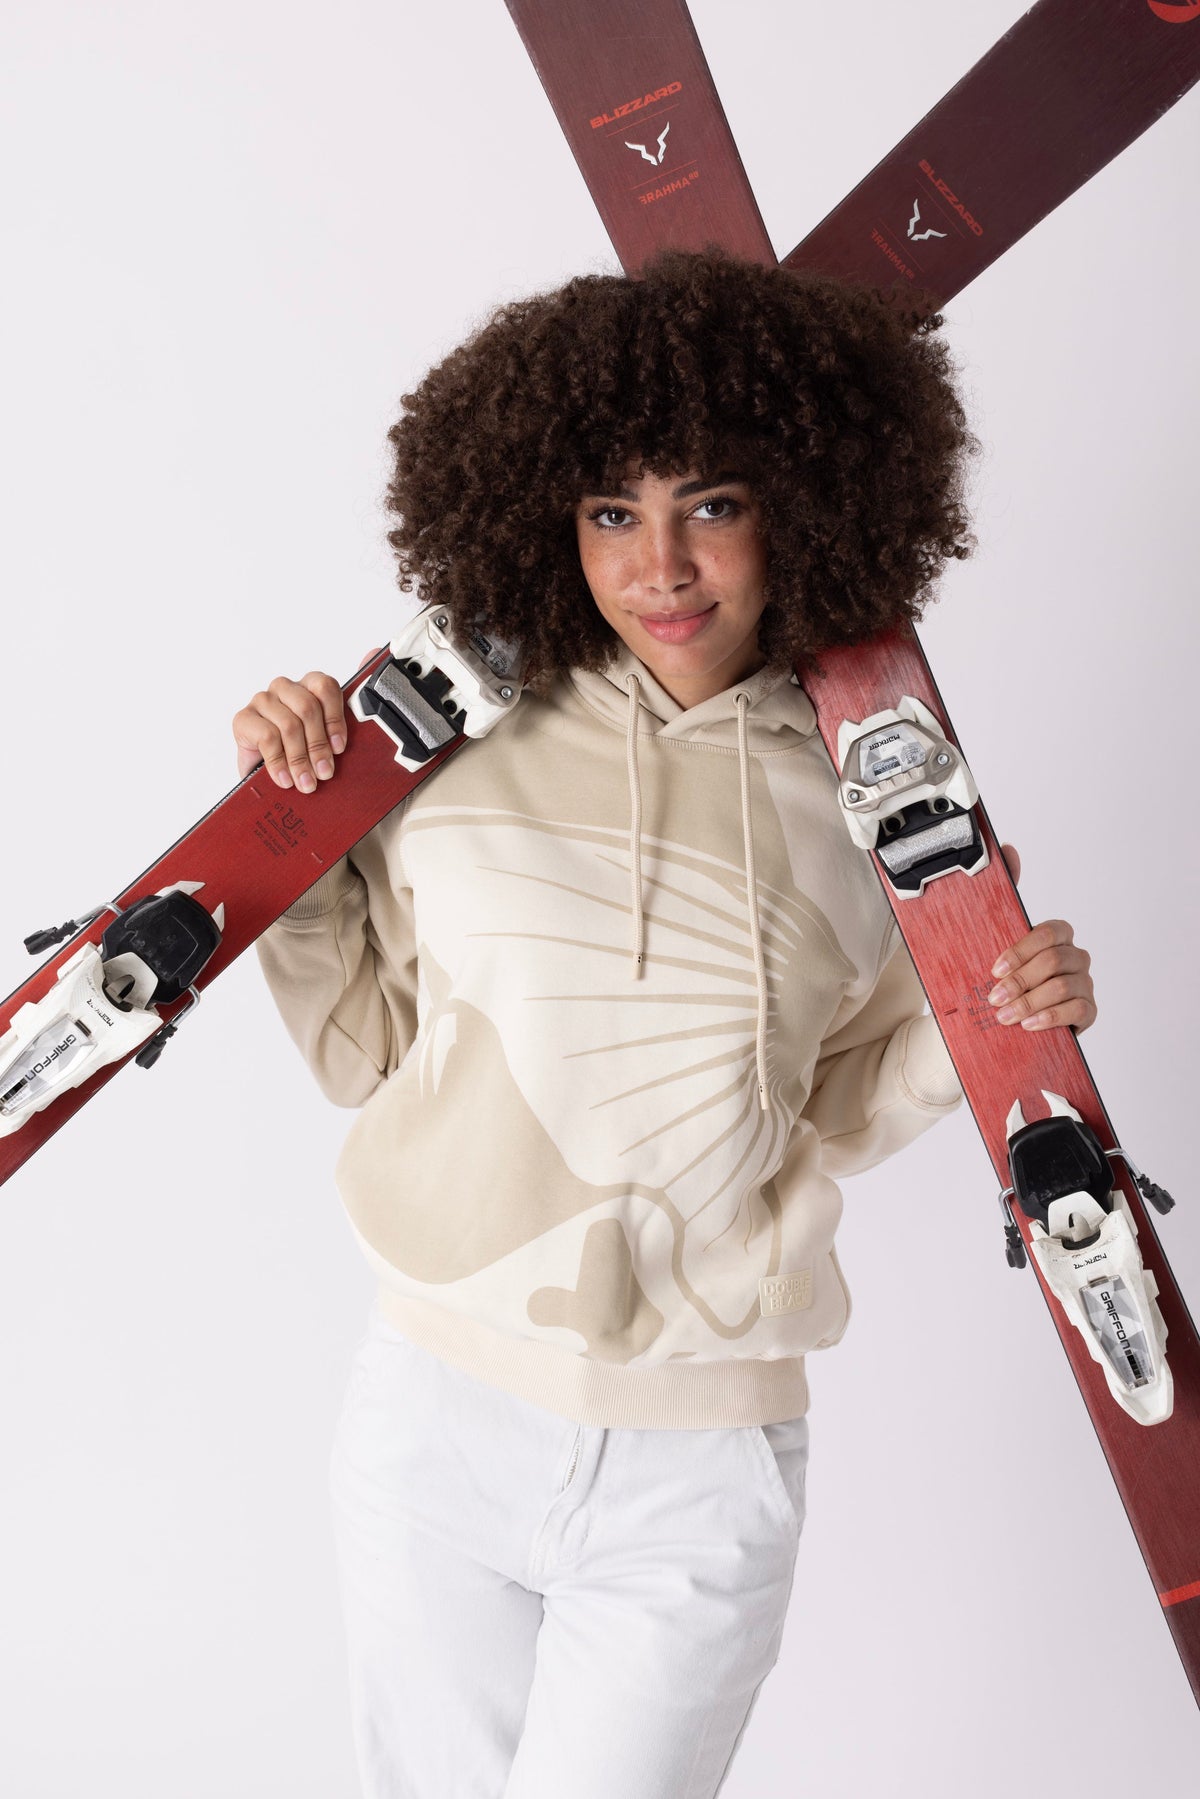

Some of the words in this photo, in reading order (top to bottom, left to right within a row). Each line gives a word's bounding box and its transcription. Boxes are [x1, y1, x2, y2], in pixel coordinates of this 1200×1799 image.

[590, 81, 682, 129] BLIZZARD
[918, 159, 984, 236] BLIZZARD
[868, 733, 900, 751] MARKER
[86, 998, 115, 1027] MARR
[24, 1033, 77, 1081] GRIFFON
[1100, 1291, 1131, 1352] GRIFFON
